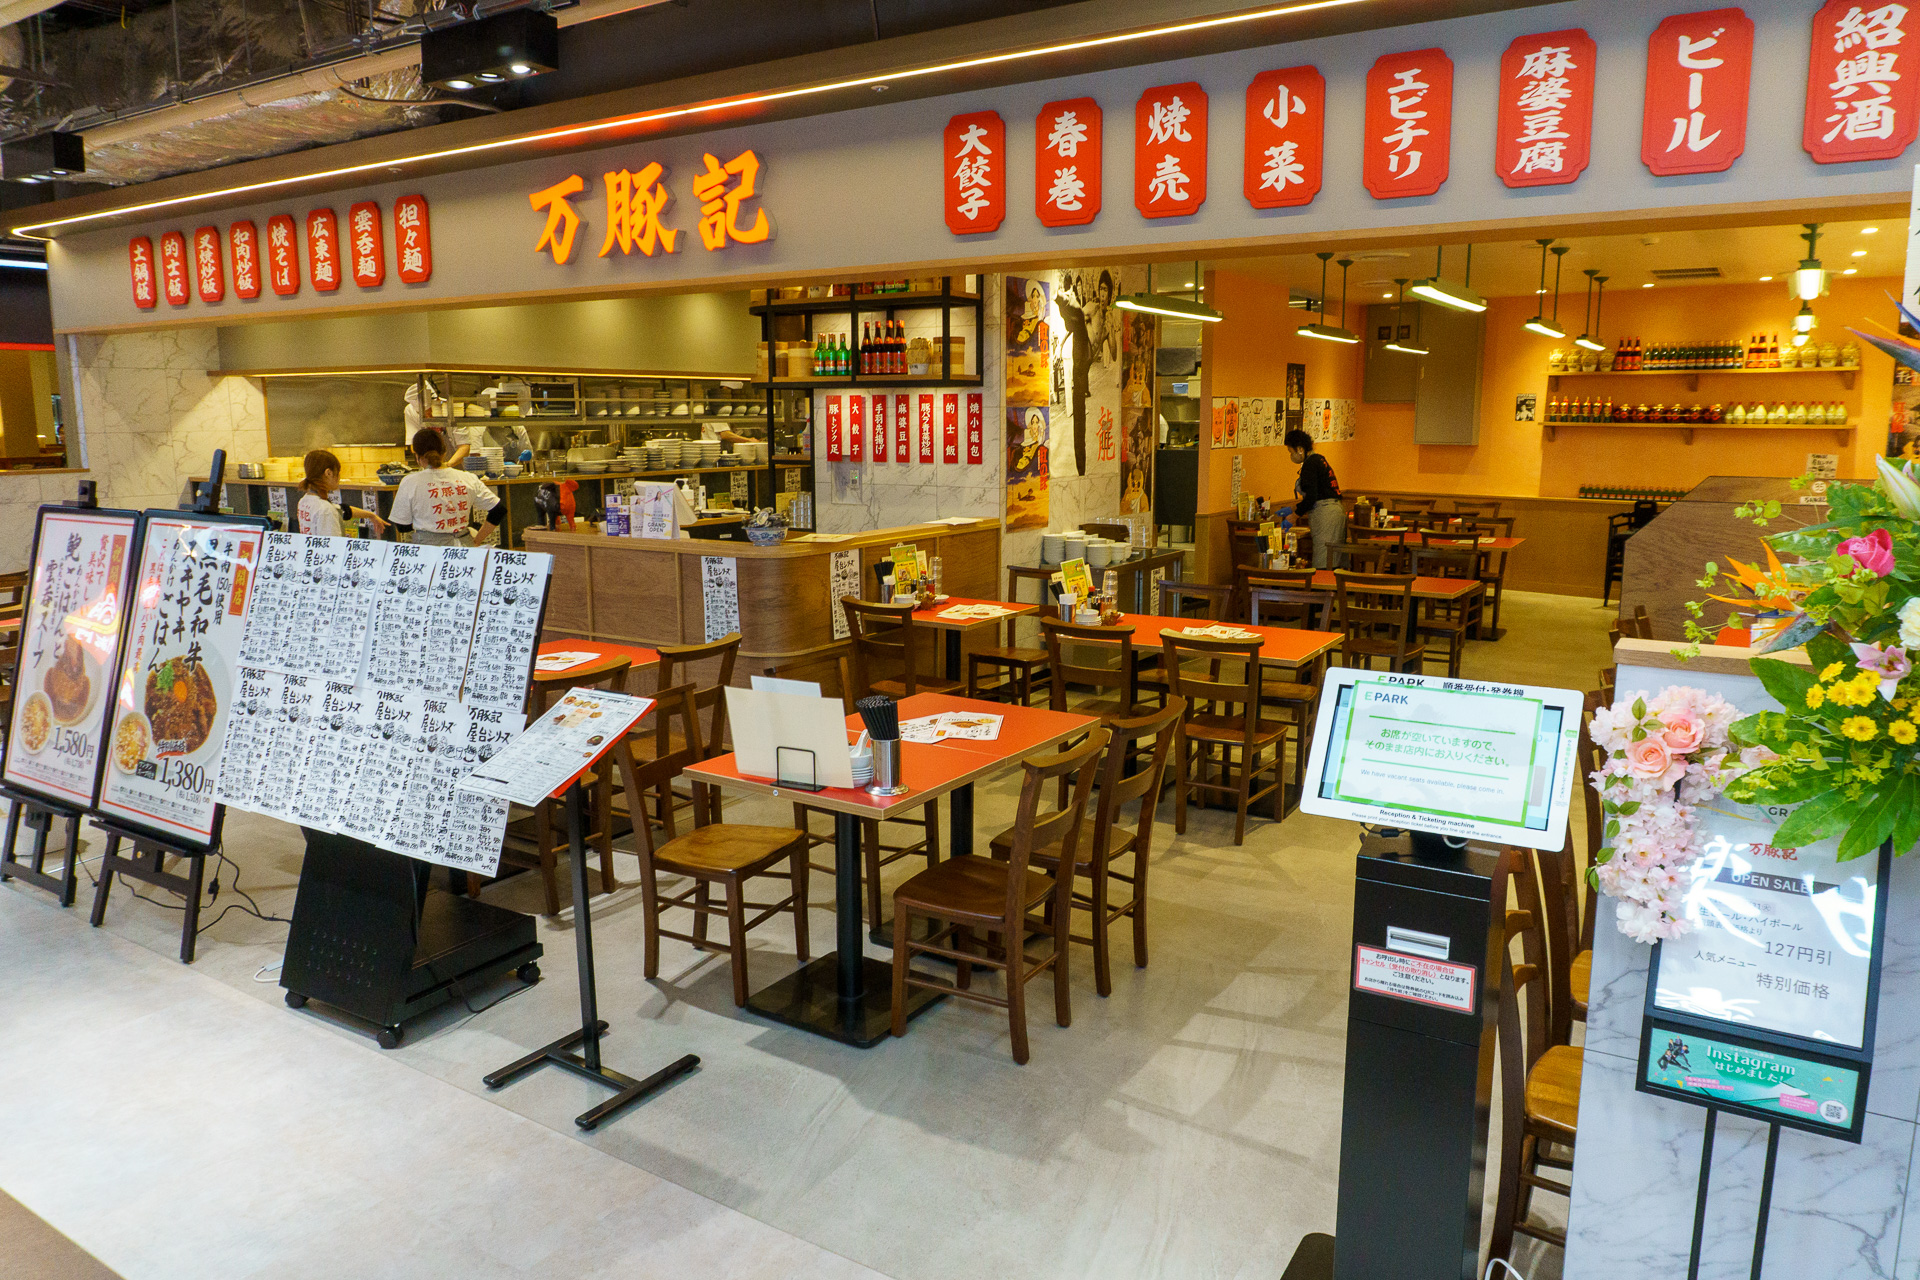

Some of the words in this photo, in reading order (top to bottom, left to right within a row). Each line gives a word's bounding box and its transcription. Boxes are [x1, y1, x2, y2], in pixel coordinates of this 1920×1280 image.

[1666, 27, 1727, 153] ビール
[1822, 2, 1910, 144] 紹興酒
[1260, 84, 1307, 192] 小菜
[1382, 66, 1431, 180] エビチリ
[1510, 46, 1578, 175] 麻婆豆腐
[952, 124, 991, 221] 大餃子
[1045, 110, 1088, 212] 春巻
[1145, 95, 1193, 204] 焼売
[528, 149, 769, 265] 万豚記
[271, 224, 291, 287] 焼そば
[311, 216, 333, 283] 広東麺
[354, 209, 377, 279] 雲呑麺
[399, 203, 423, 274] 担々麺
[164, 239, 184, 298] 的士飯
[874, 403, 885, 455] 手羽先揚げ
[898, 403, 908, 456] 麻婆豆腐
[945, 402, 956, 457] 的士飯
[428, 485, 467, 498] 万豚記
[1364, 691, 1409, 705] EPARK
[1365, 740, 1510, 767] そのまま店内にお入りください。
[1381, 728, 1497, 752] お席が空いていますので、
[159, 757, 215, 795] 1,380円
[1380, 809, 1411, 819] Reception
[1418, 815, 1447, 826] Ticketing
[1447, 820, 1475, 829] machine
[1749, 842, 1798, 861] 万豚記
[1732, 873, 1770, 888] OPEN
[1773, 879, 1809, 894] SALE
[1694, 950, 1758, 967] 人気メニュー
[1765, 941, 1832, 966] 127円引
[1756, 972, 1830, 1000] 特別価格
[1706, 1046, 1796, 1076] Instagram
